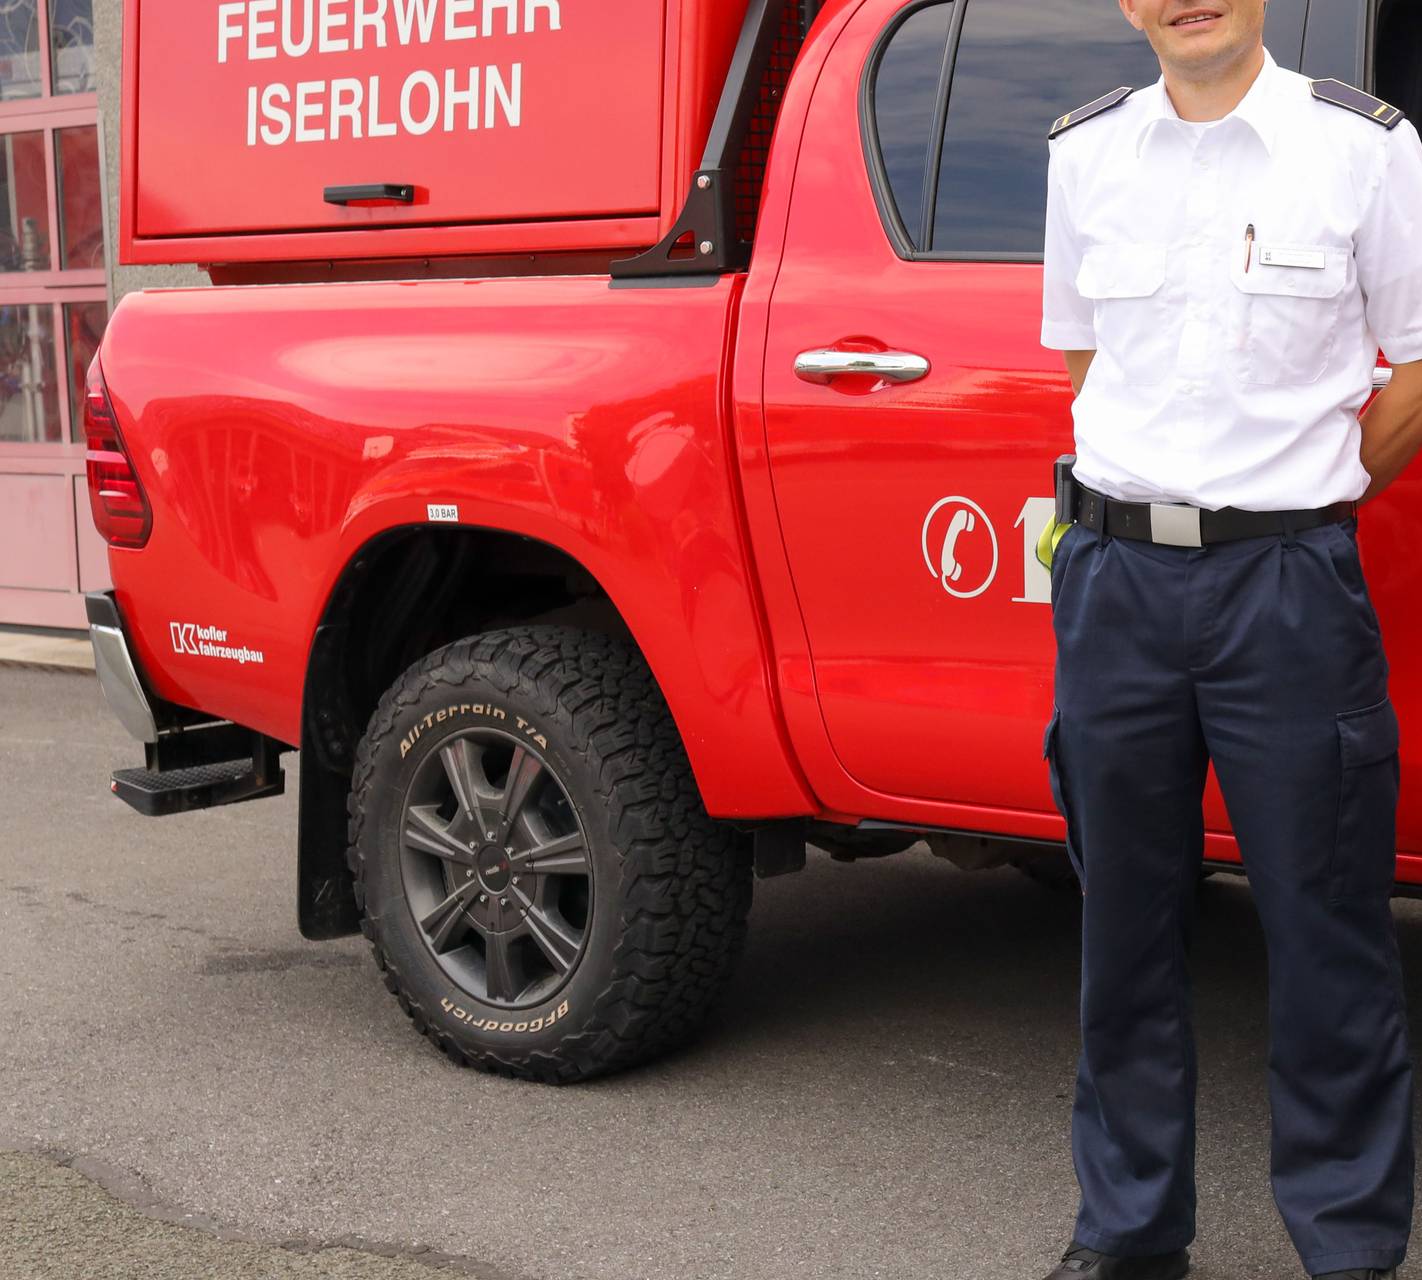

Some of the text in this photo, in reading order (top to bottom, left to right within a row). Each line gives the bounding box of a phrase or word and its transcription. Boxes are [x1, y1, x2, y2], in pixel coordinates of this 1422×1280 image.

[247, 63, 522, 146] ISERLOHN
[441, 508, 456, 519] BAR
[196, 624, 227, 642] kofler
[198, 640, 264, 664] fahrzeugbau
[400, 703, 549, 759] All-Terrain T/A
[440, 998, 569, 1033] BFGoodrich
